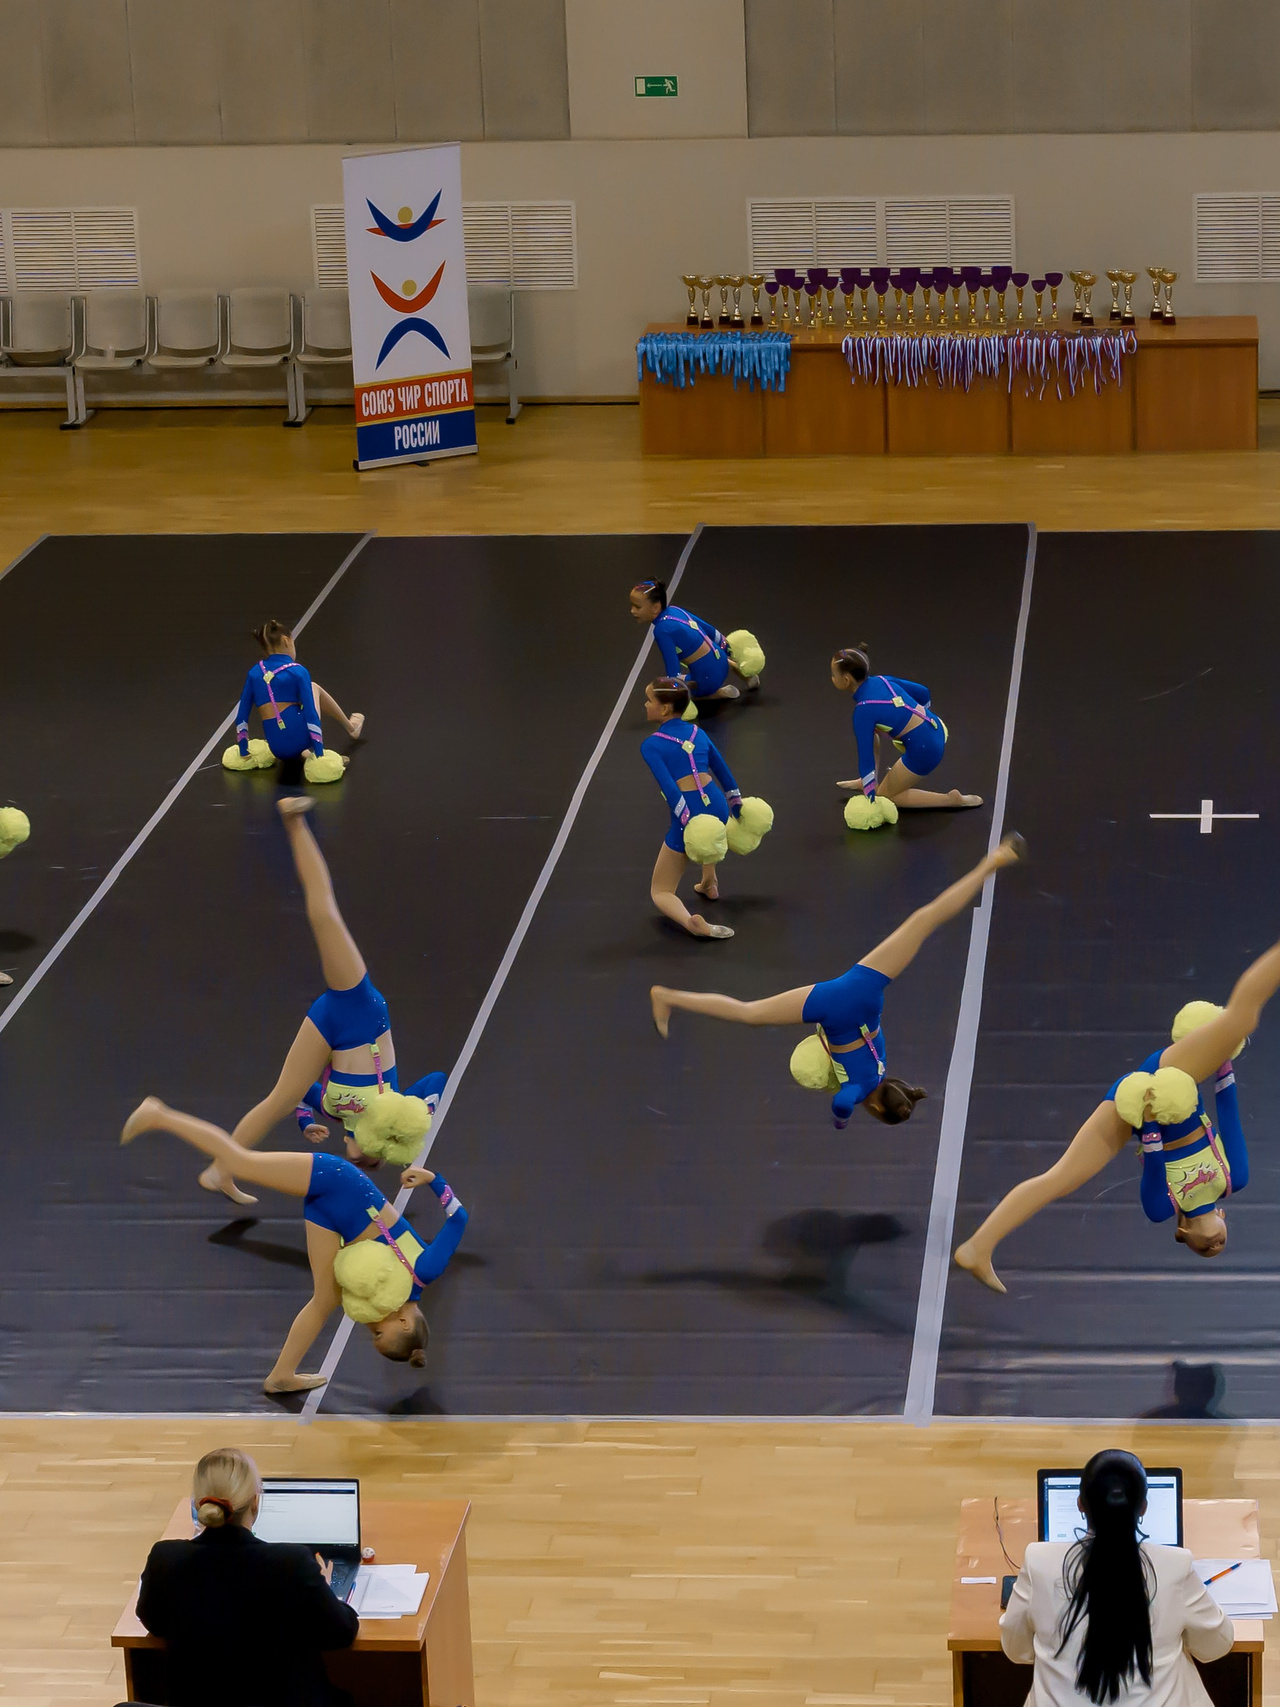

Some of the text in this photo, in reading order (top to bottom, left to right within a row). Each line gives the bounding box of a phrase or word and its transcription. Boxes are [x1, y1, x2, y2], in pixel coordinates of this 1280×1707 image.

[361, 377, 468, 417] СОЮЗ ЧИР СПОРТА
[394, 419, 440, 450] РОССИИ
